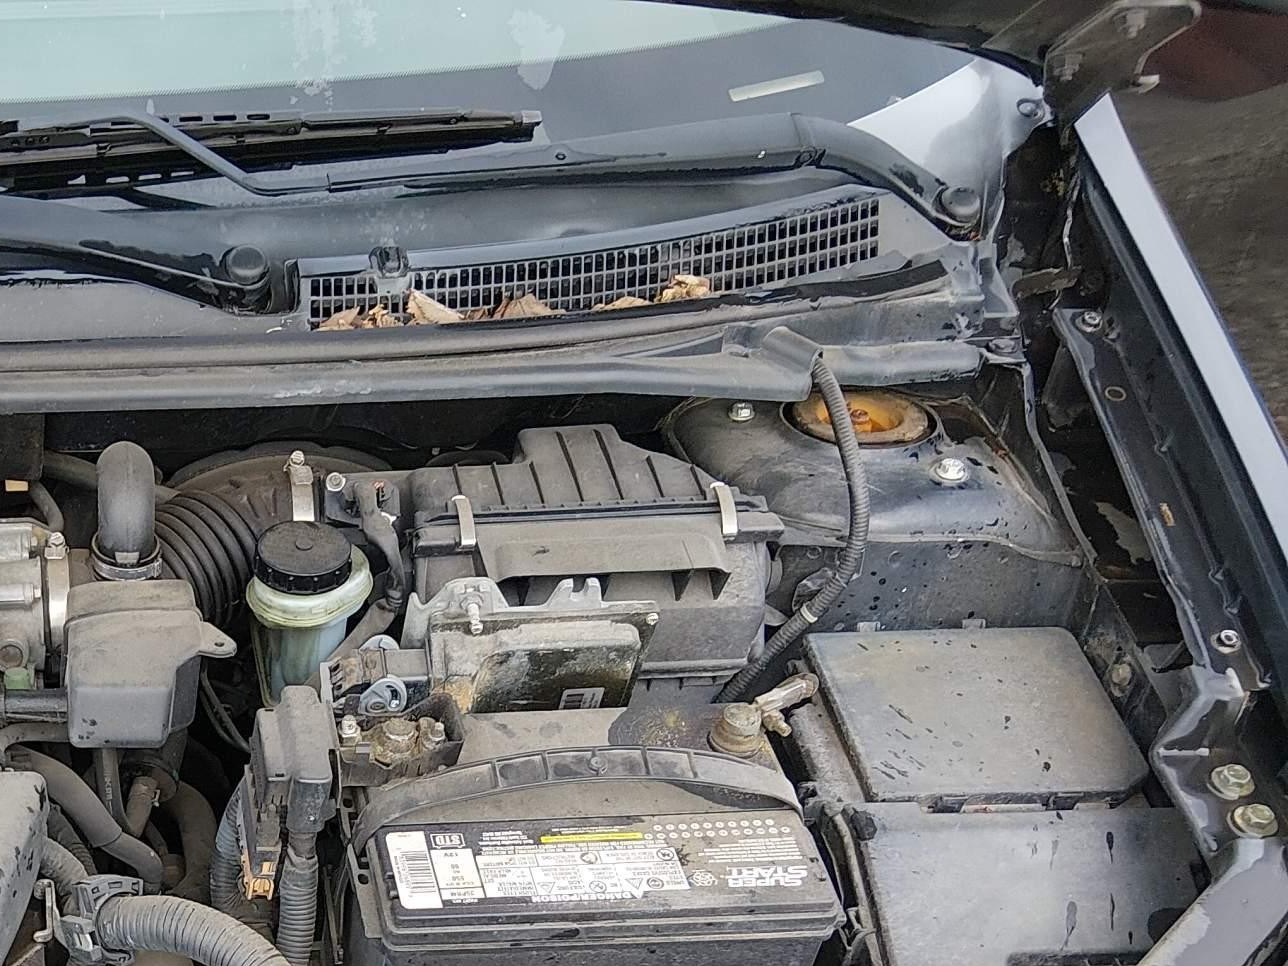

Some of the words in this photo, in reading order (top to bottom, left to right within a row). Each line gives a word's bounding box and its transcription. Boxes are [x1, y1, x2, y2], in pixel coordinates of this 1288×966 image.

[435, 835, 460, 845] STD
[725, 864, 808, 878] START
[727, 876, 803, 888] SUPER
